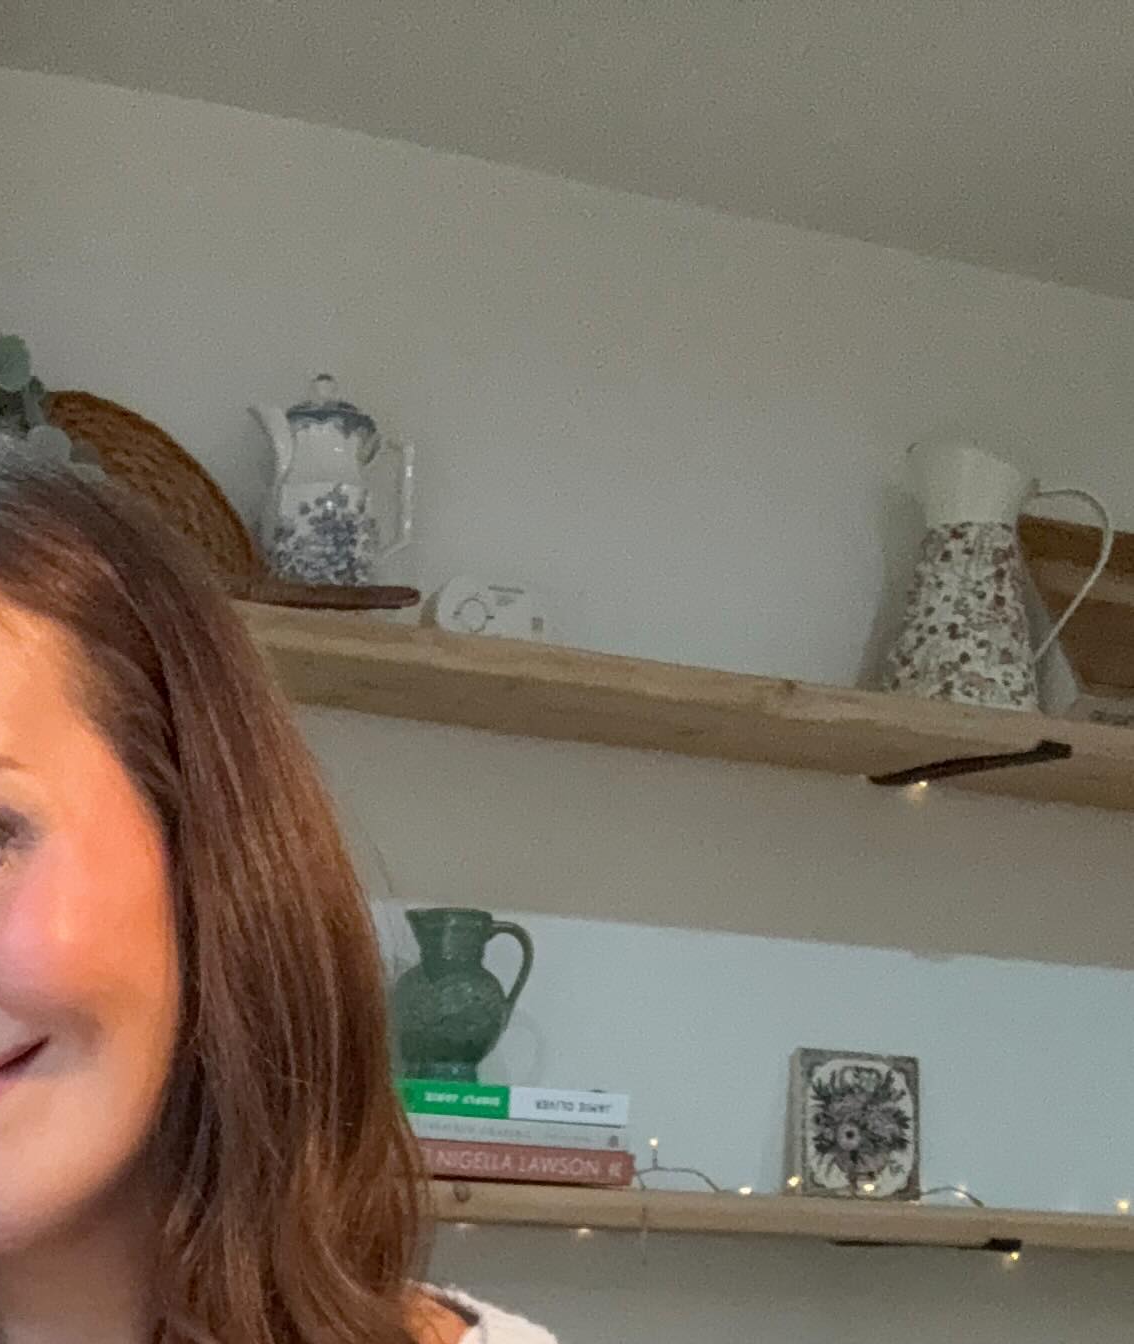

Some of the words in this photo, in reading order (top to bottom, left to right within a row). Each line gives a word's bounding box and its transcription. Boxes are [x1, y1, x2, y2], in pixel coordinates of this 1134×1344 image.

[535, 1099, 575, 1112] OLIVER
[578, 1101, 613, 1114] JAMIE
[436, 1150, 511, 1172] NIGELLA
[518, 1158, 601, 1177] LAWSON
